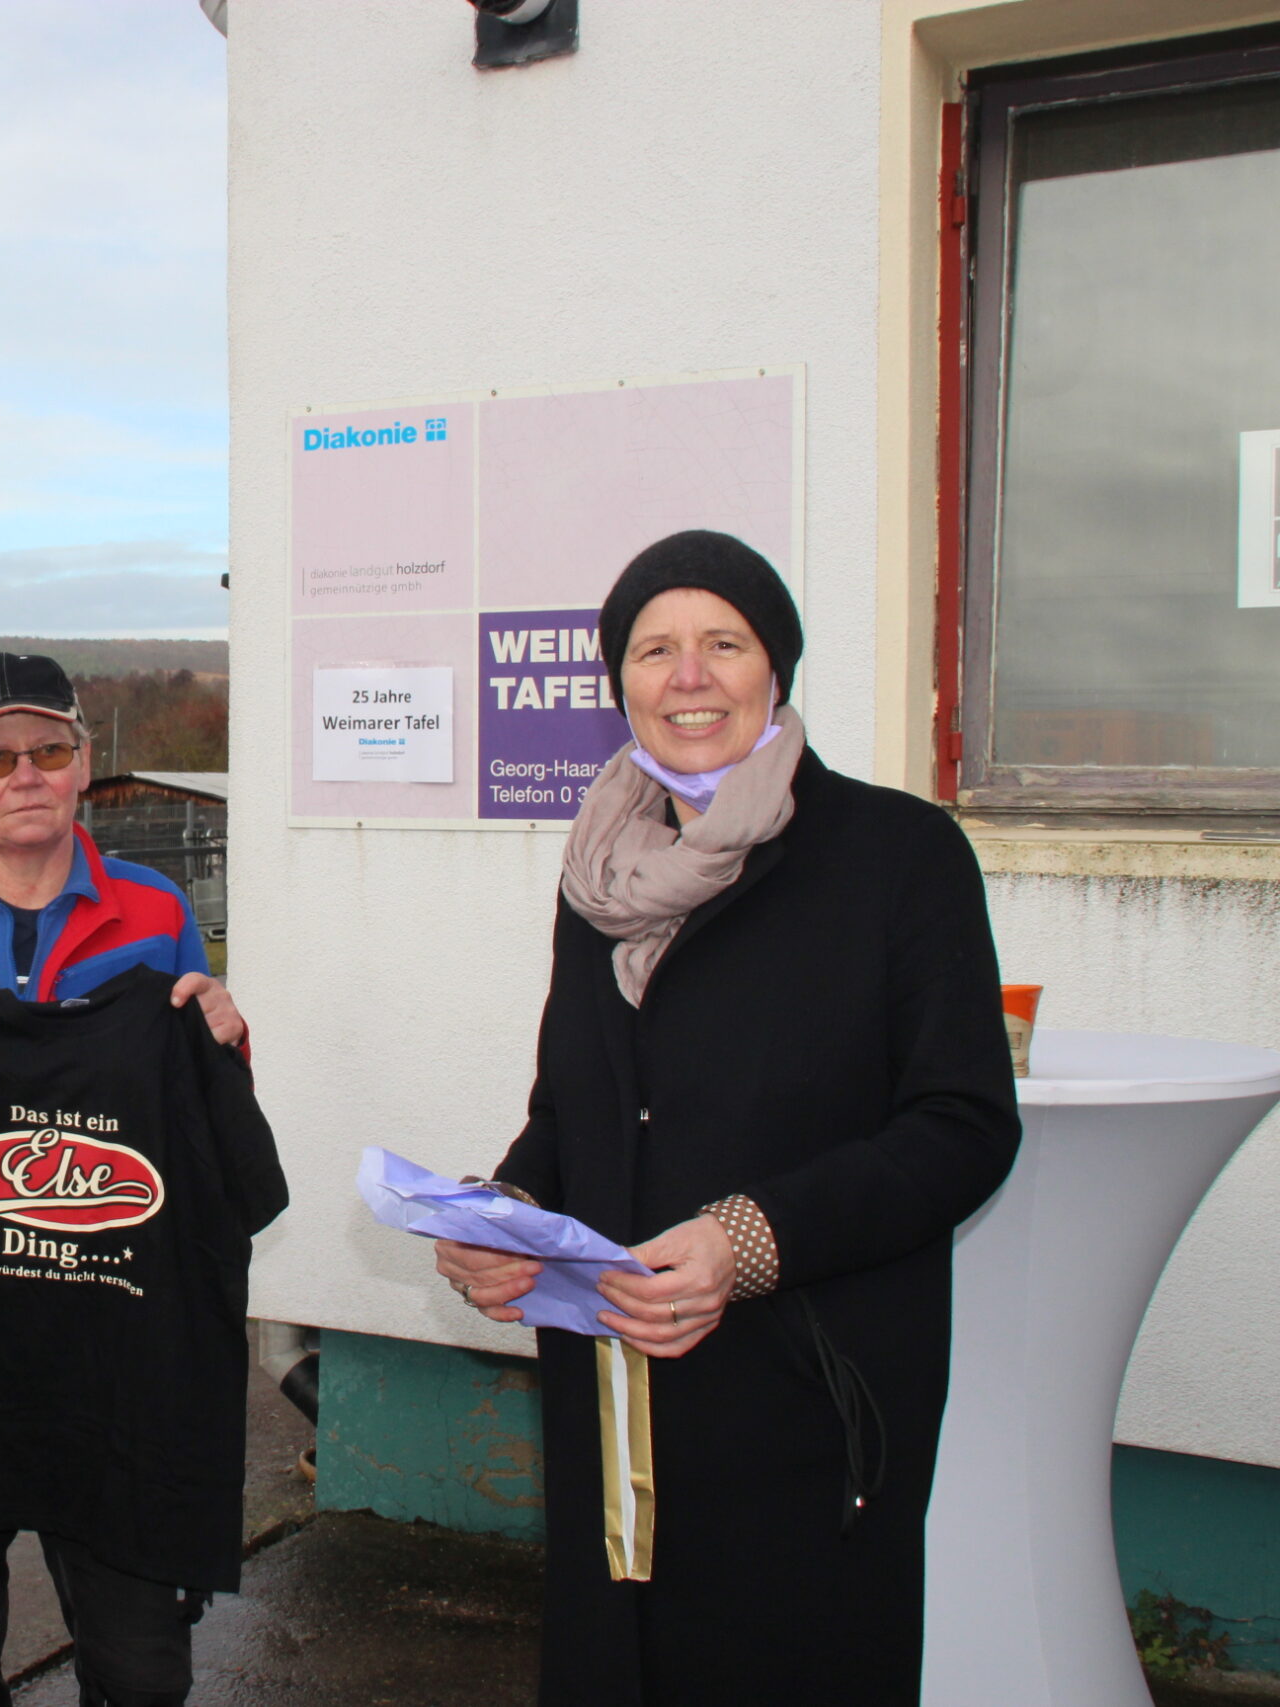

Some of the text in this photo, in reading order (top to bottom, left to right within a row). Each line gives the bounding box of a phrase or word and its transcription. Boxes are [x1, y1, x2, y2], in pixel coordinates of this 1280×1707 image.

[304, 421, 418, 451] Diakonie
[310, 561, 447, 580] diakonie landgut holzdorf
[310, 581, 422, 597] gemeinnützige gmbh
[352, 689, 412, 704] 25 Jahre
[489, 675, 618, 710] TAFEL
[322, 714, 440, 730] Weimarer Tafel
[490, 759, 613, 781] Georg-Haar-
[489, 785, 555, 803] Telefon
[560, 786, 572, 803] 0
[10, 1105, 120, 1132] Das ist ein
[1, 1128, 114, 1198] Else
[45, 1268, 61, 1281] du
[64, 1271, 96, 1282] nicht
